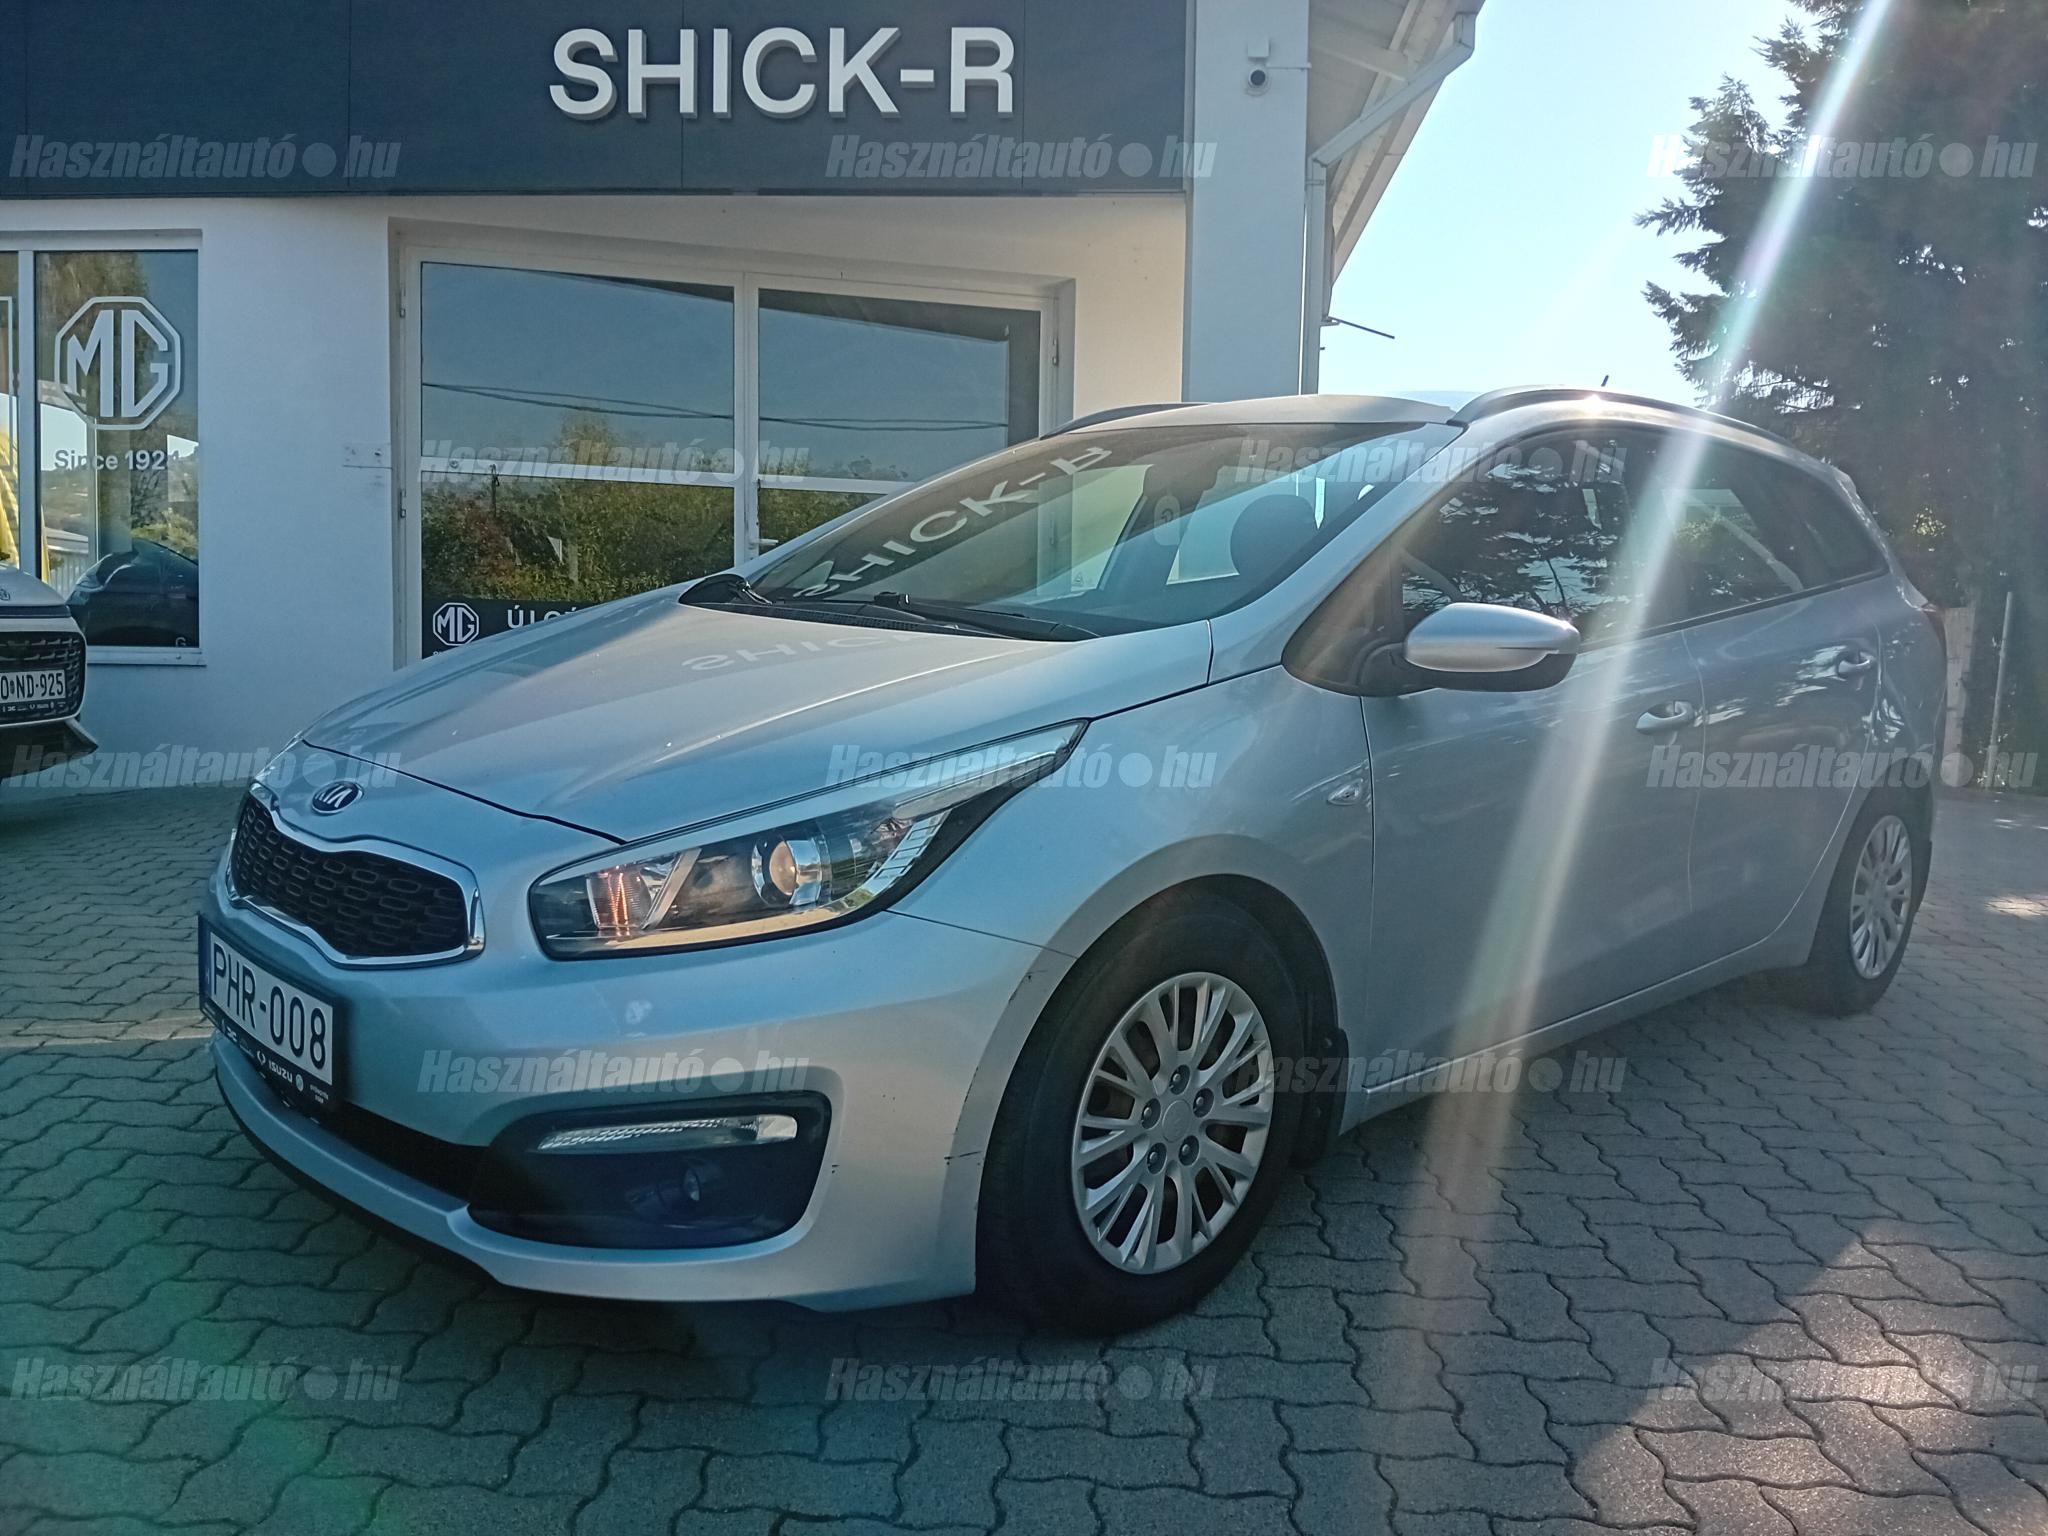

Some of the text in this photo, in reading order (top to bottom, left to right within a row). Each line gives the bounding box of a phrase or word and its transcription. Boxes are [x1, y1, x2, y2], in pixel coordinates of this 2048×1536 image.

[549, 27, 1015, 118] SHICK-R
[67, 309, 168, 417] MG
[54, 450, 118, 471] Since
[437, 606, 475, 643] MG
[213, 943, 326, 1070] PHR-008
